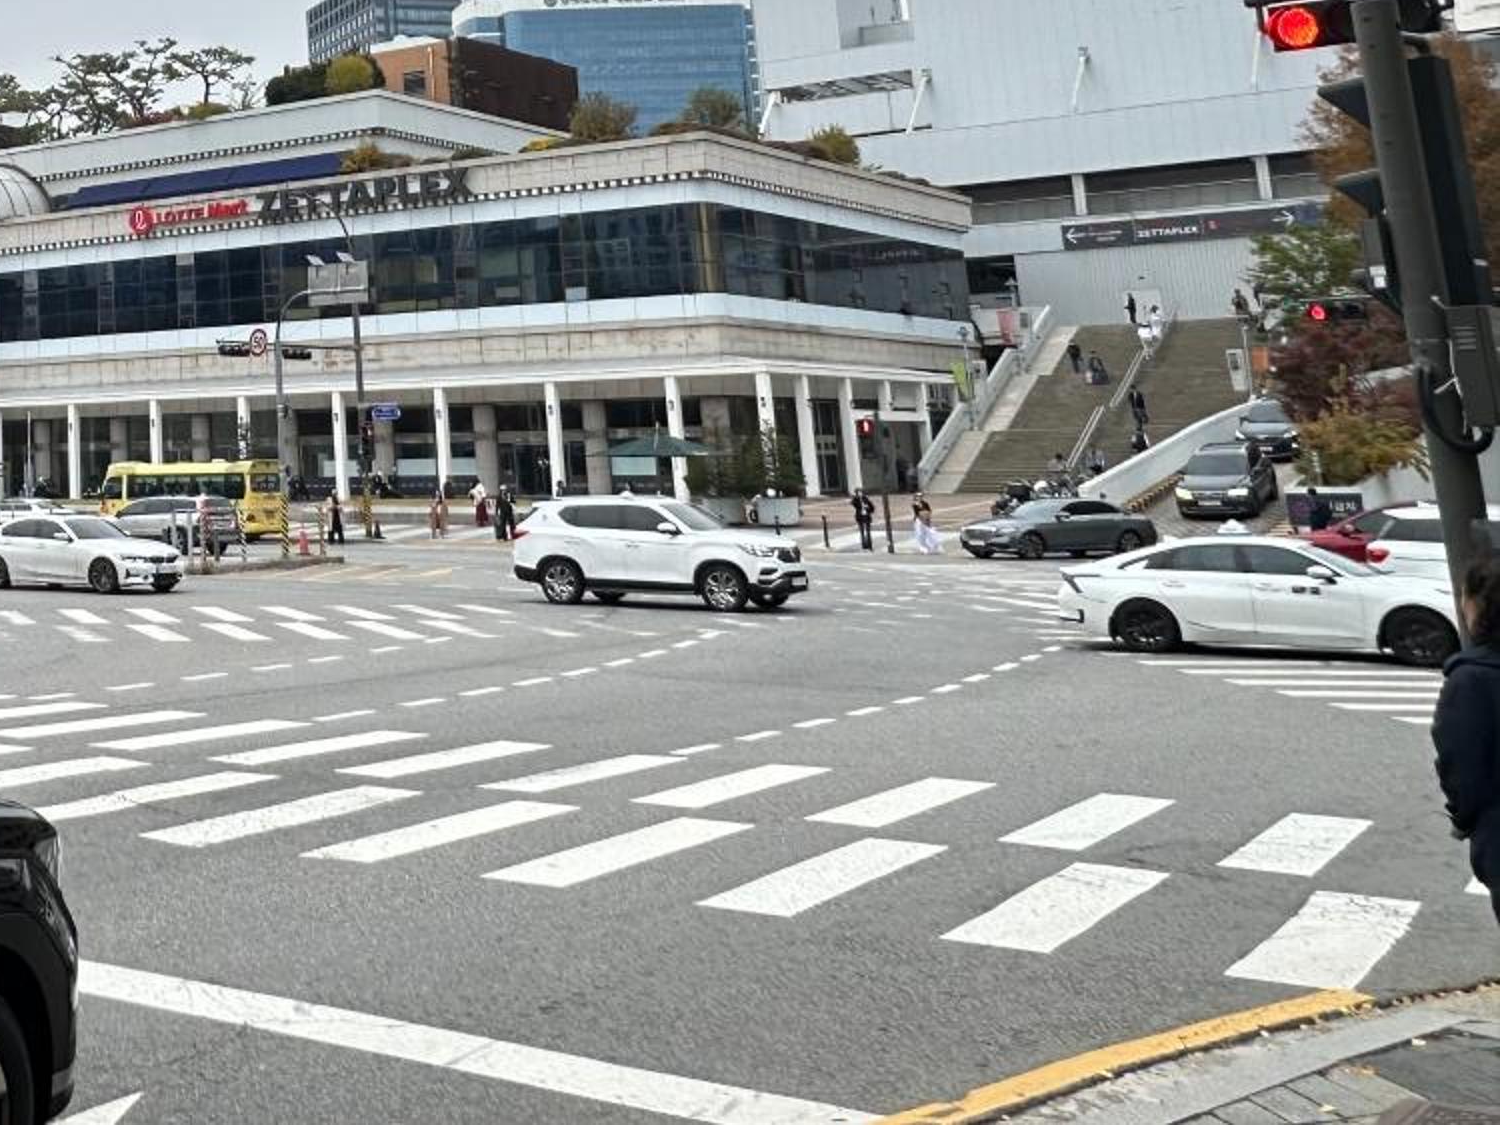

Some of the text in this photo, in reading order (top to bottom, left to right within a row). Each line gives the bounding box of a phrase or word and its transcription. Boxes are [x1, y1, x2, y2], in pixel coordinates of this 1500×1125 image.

[153, 167, 474, 225] LOTTE Mart ZETTAPLEX
